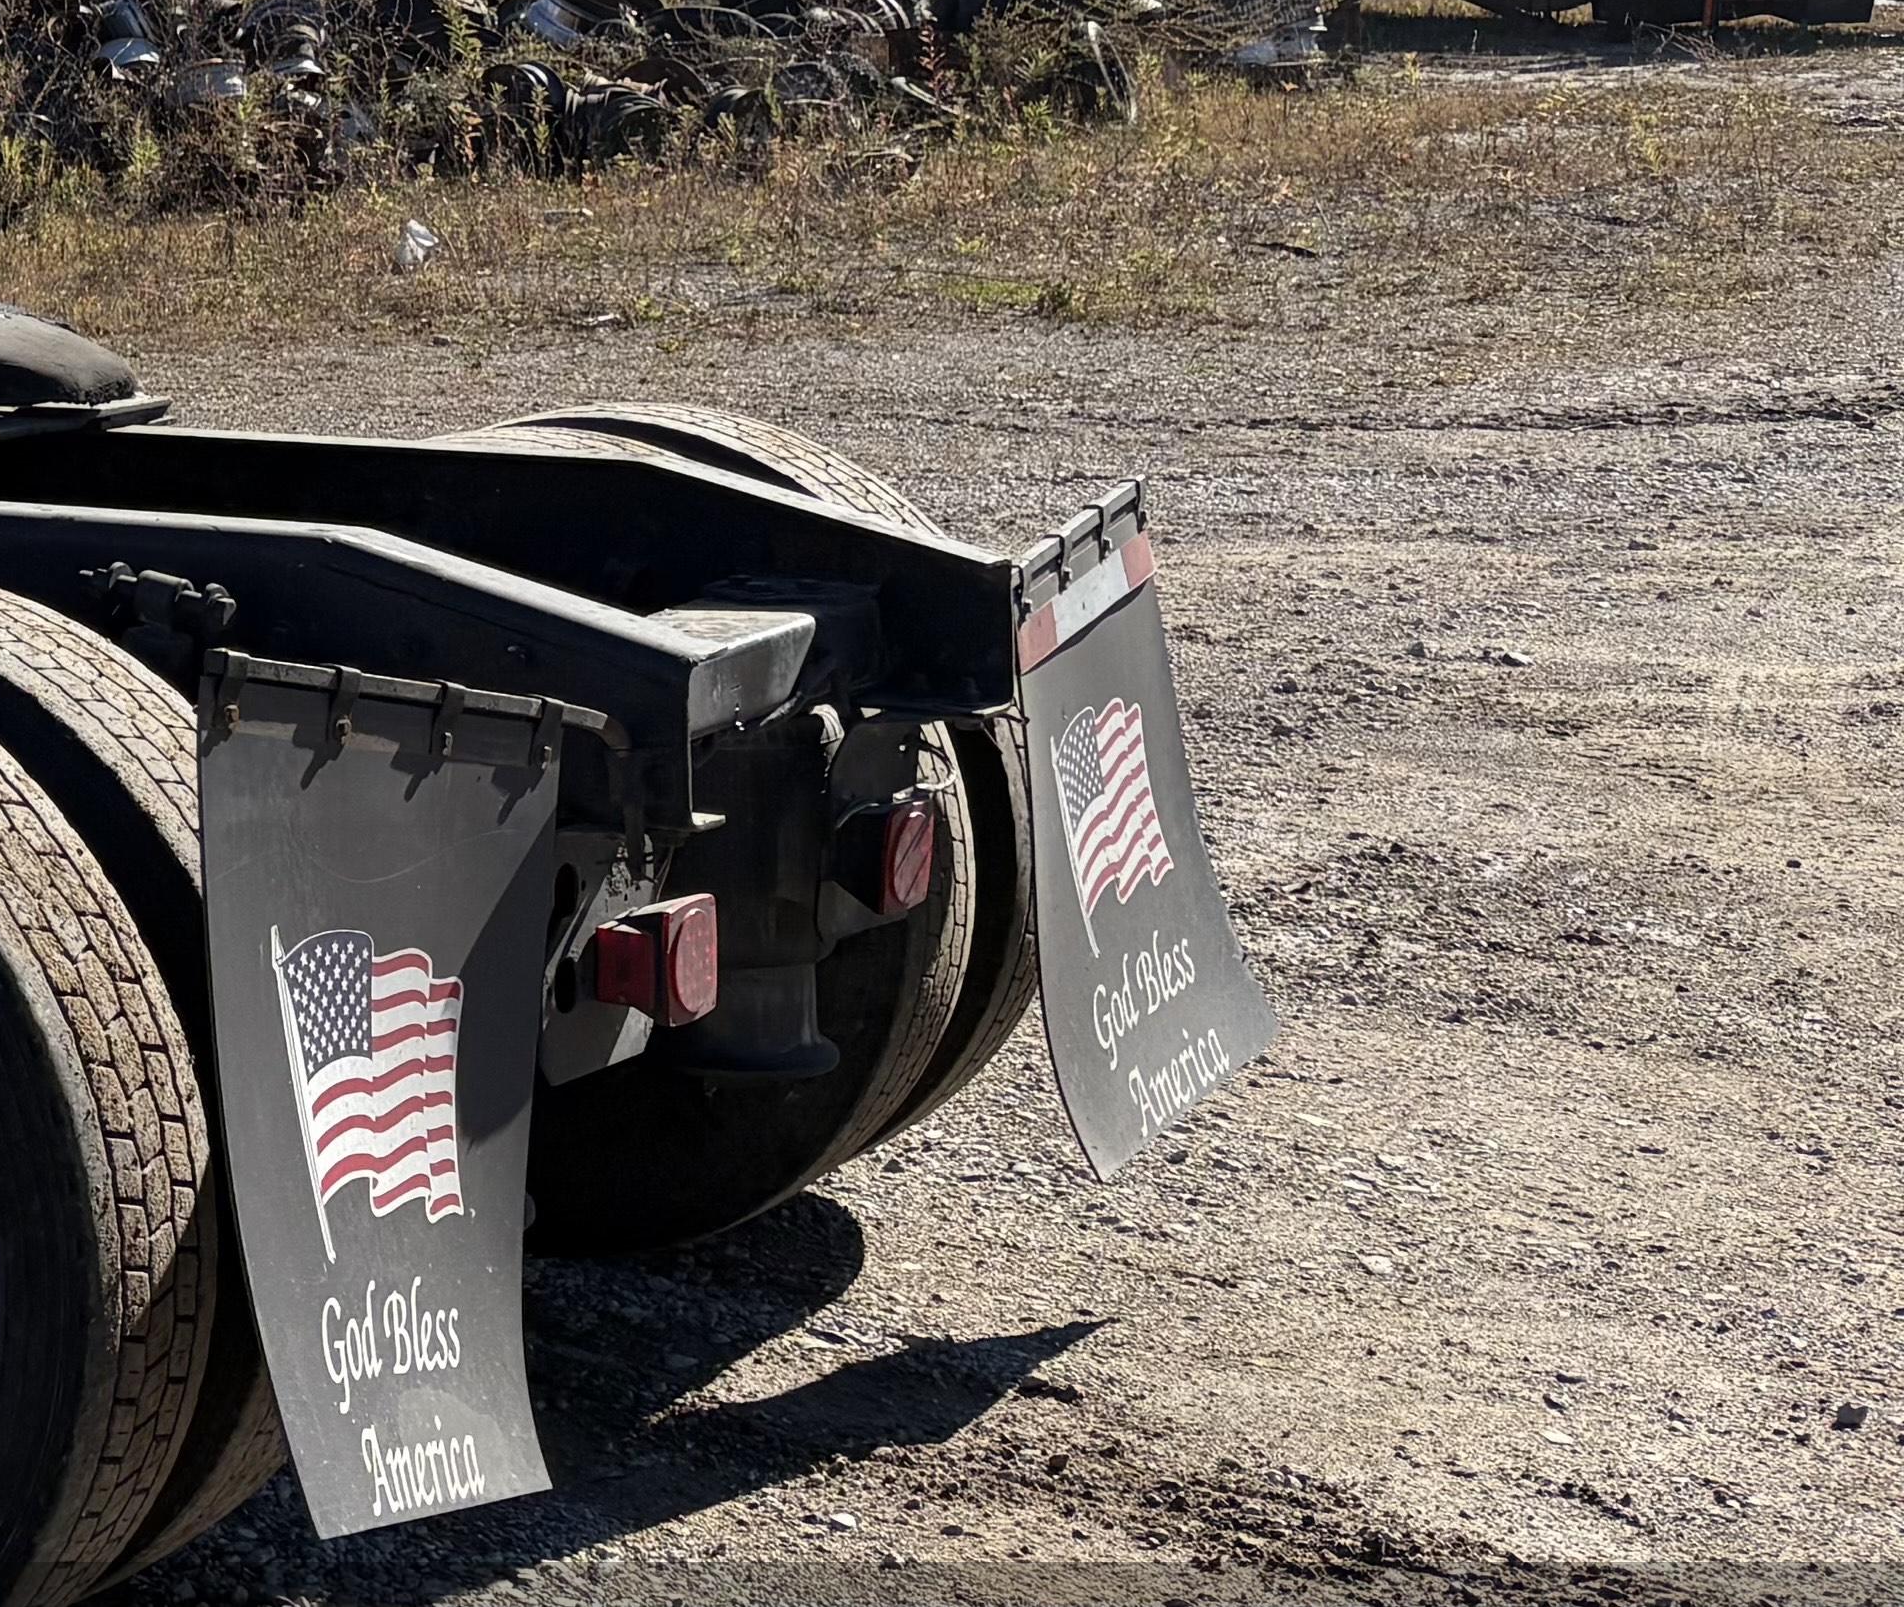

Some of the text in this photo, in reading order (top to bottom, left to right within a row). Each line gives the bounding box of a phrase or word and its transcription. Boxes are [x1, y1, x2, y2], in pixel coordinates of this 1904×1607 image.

[1093, 929, 1196, 1072] God Bless
[1128, 1026, 1231, 1138] America
[321, 1275, 461, 1414] God Bless
[361, 1414, 486, 1517] America
